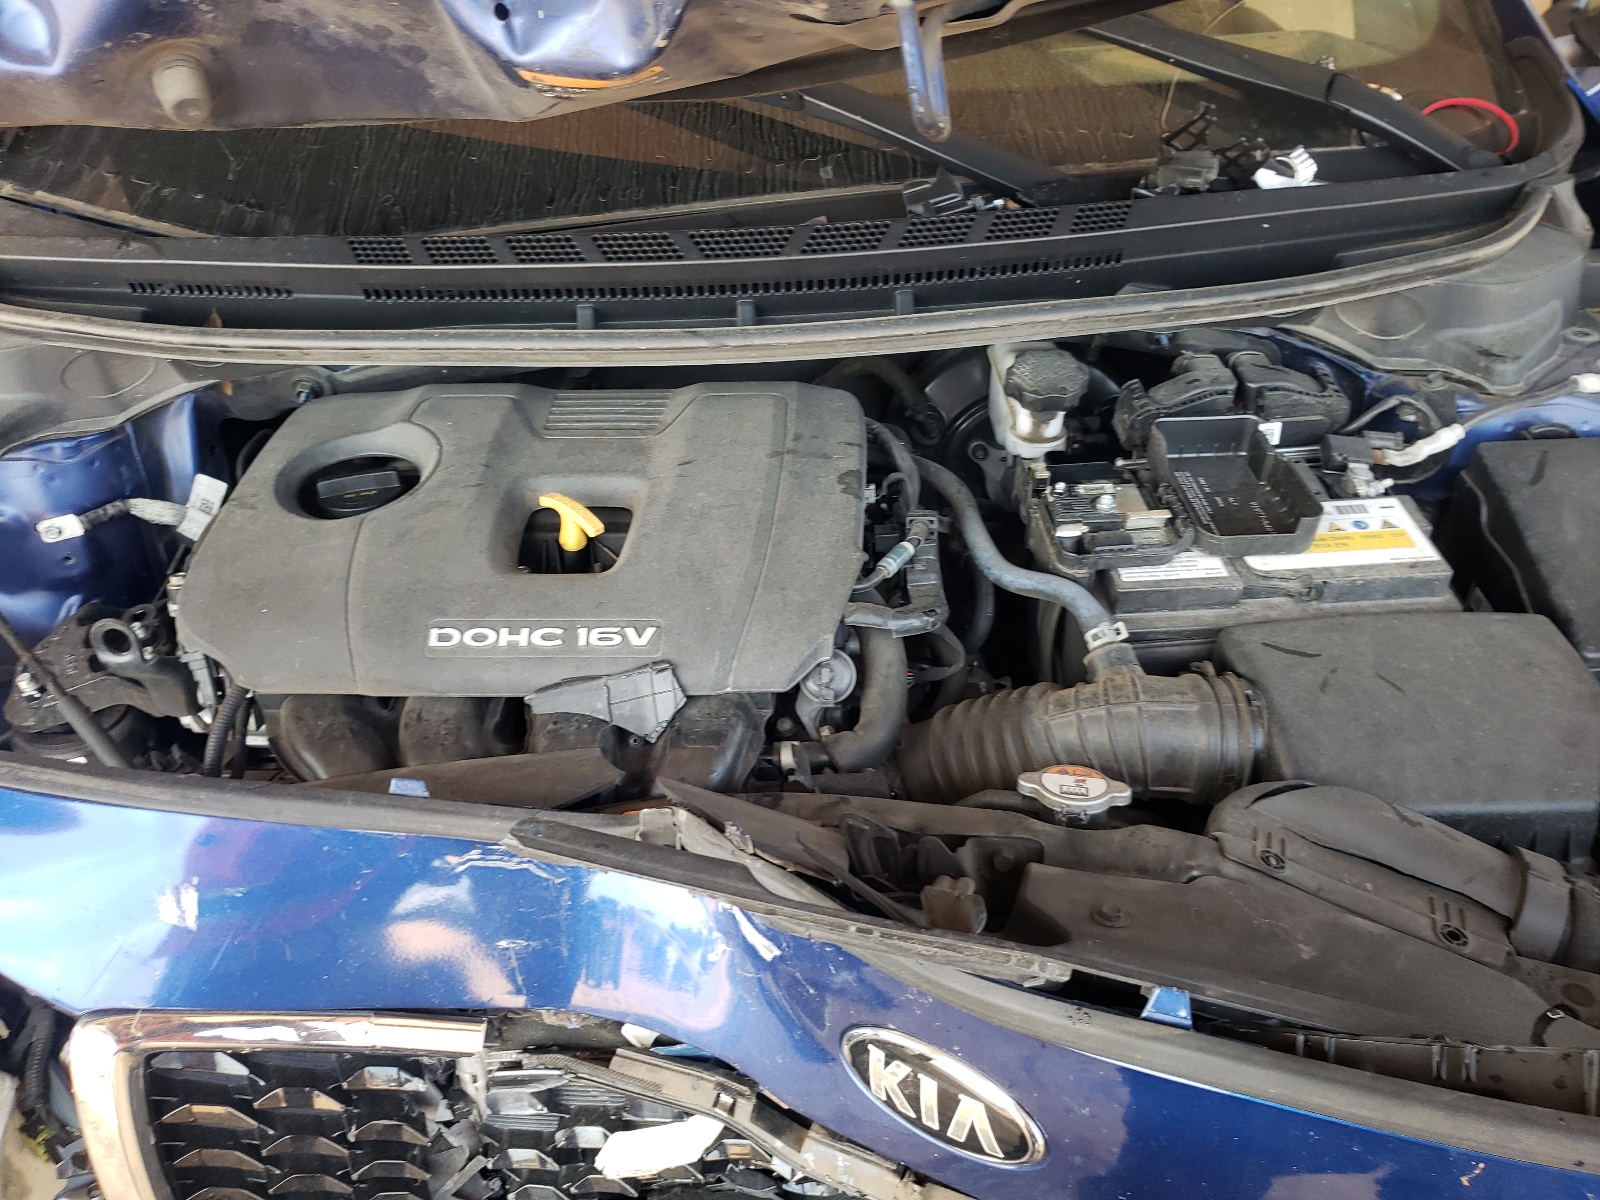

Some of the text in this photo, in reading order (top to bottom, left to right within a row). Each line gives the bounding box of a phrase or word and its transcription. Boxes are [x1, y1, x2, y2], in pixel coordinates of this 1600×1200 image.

[427, 625, 659, 648] DOHC 16V
[866, 1043, 1005, 1158] KIA
